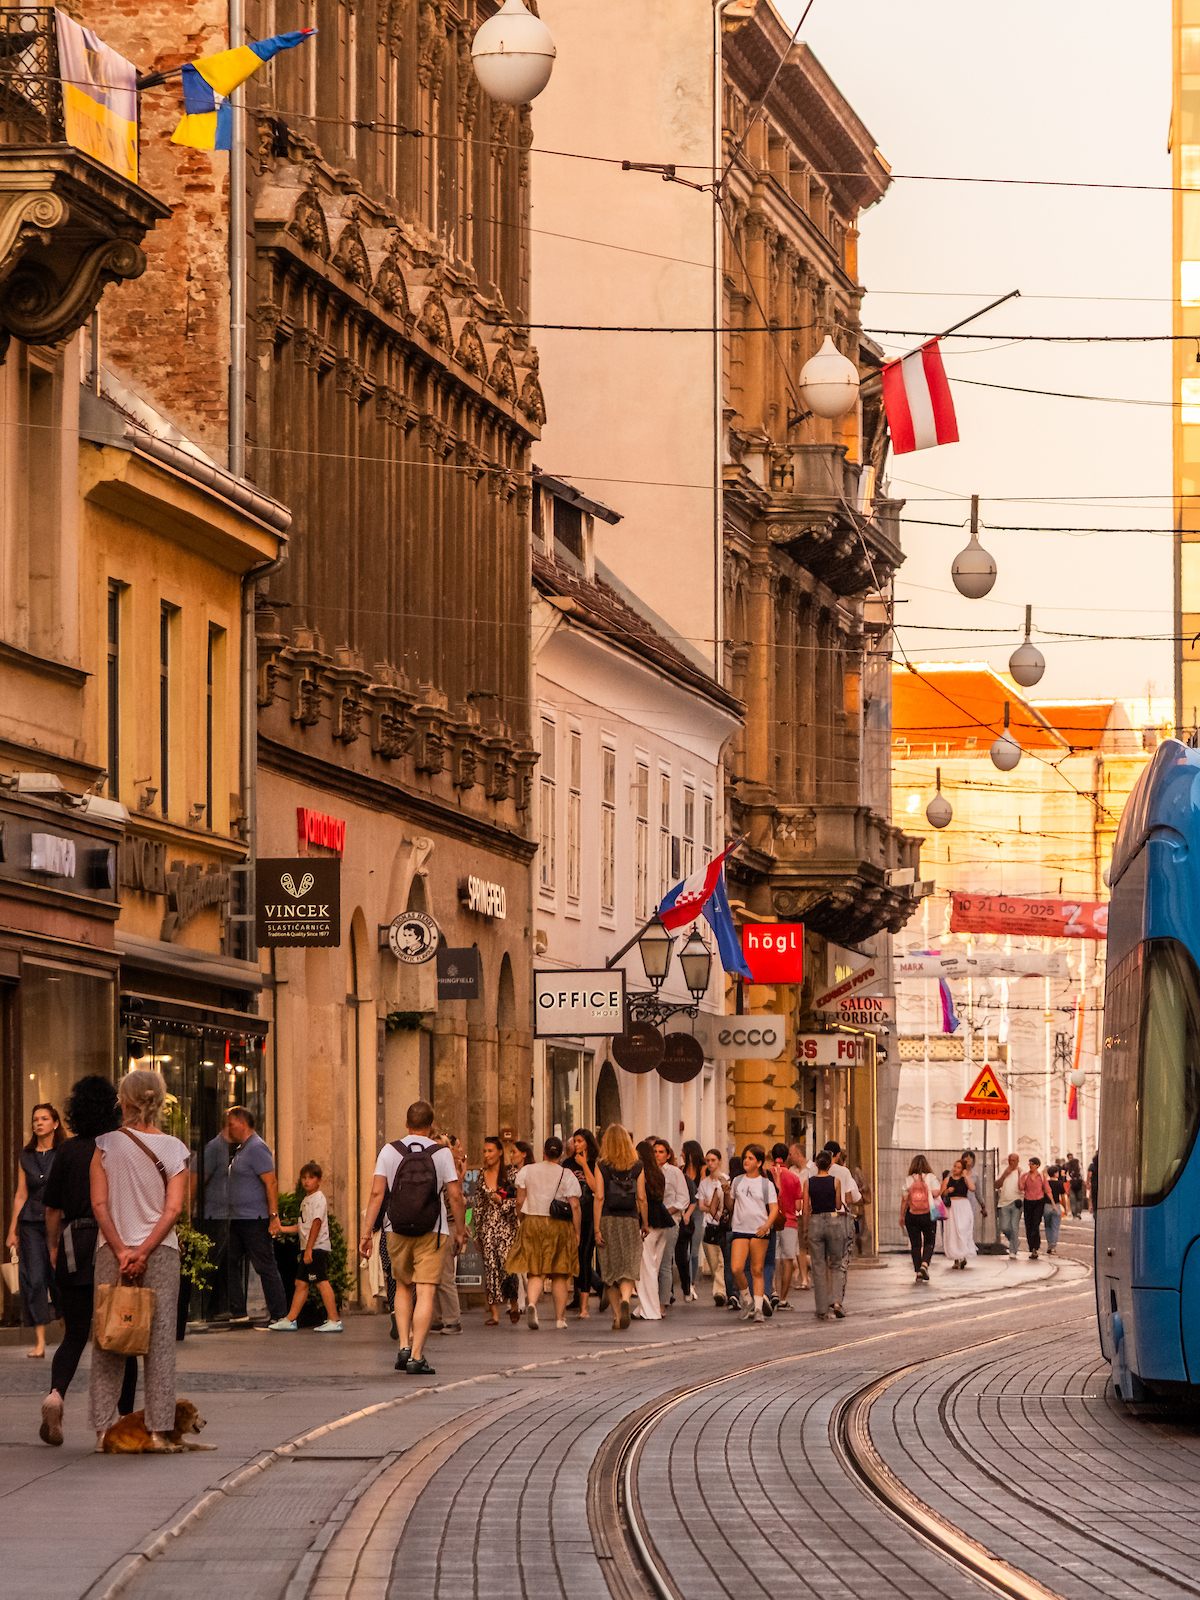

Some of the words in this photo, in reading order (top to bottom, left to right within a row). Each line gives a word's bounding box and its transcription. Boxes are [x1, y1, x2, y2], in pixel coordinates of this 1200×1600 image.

[468, 874, 507, 919] SPRINGFIELD
[264, 904, 330, 918] VINCEK
[392, 912, 416, 928] THOMAS
[539, 991, 619, 1009] OFFICE
[840, 997, 882, 1011] SALON
[718, 1029, 777, 1046] ecco
[969, 1106, 998, 1116] Pješaci
